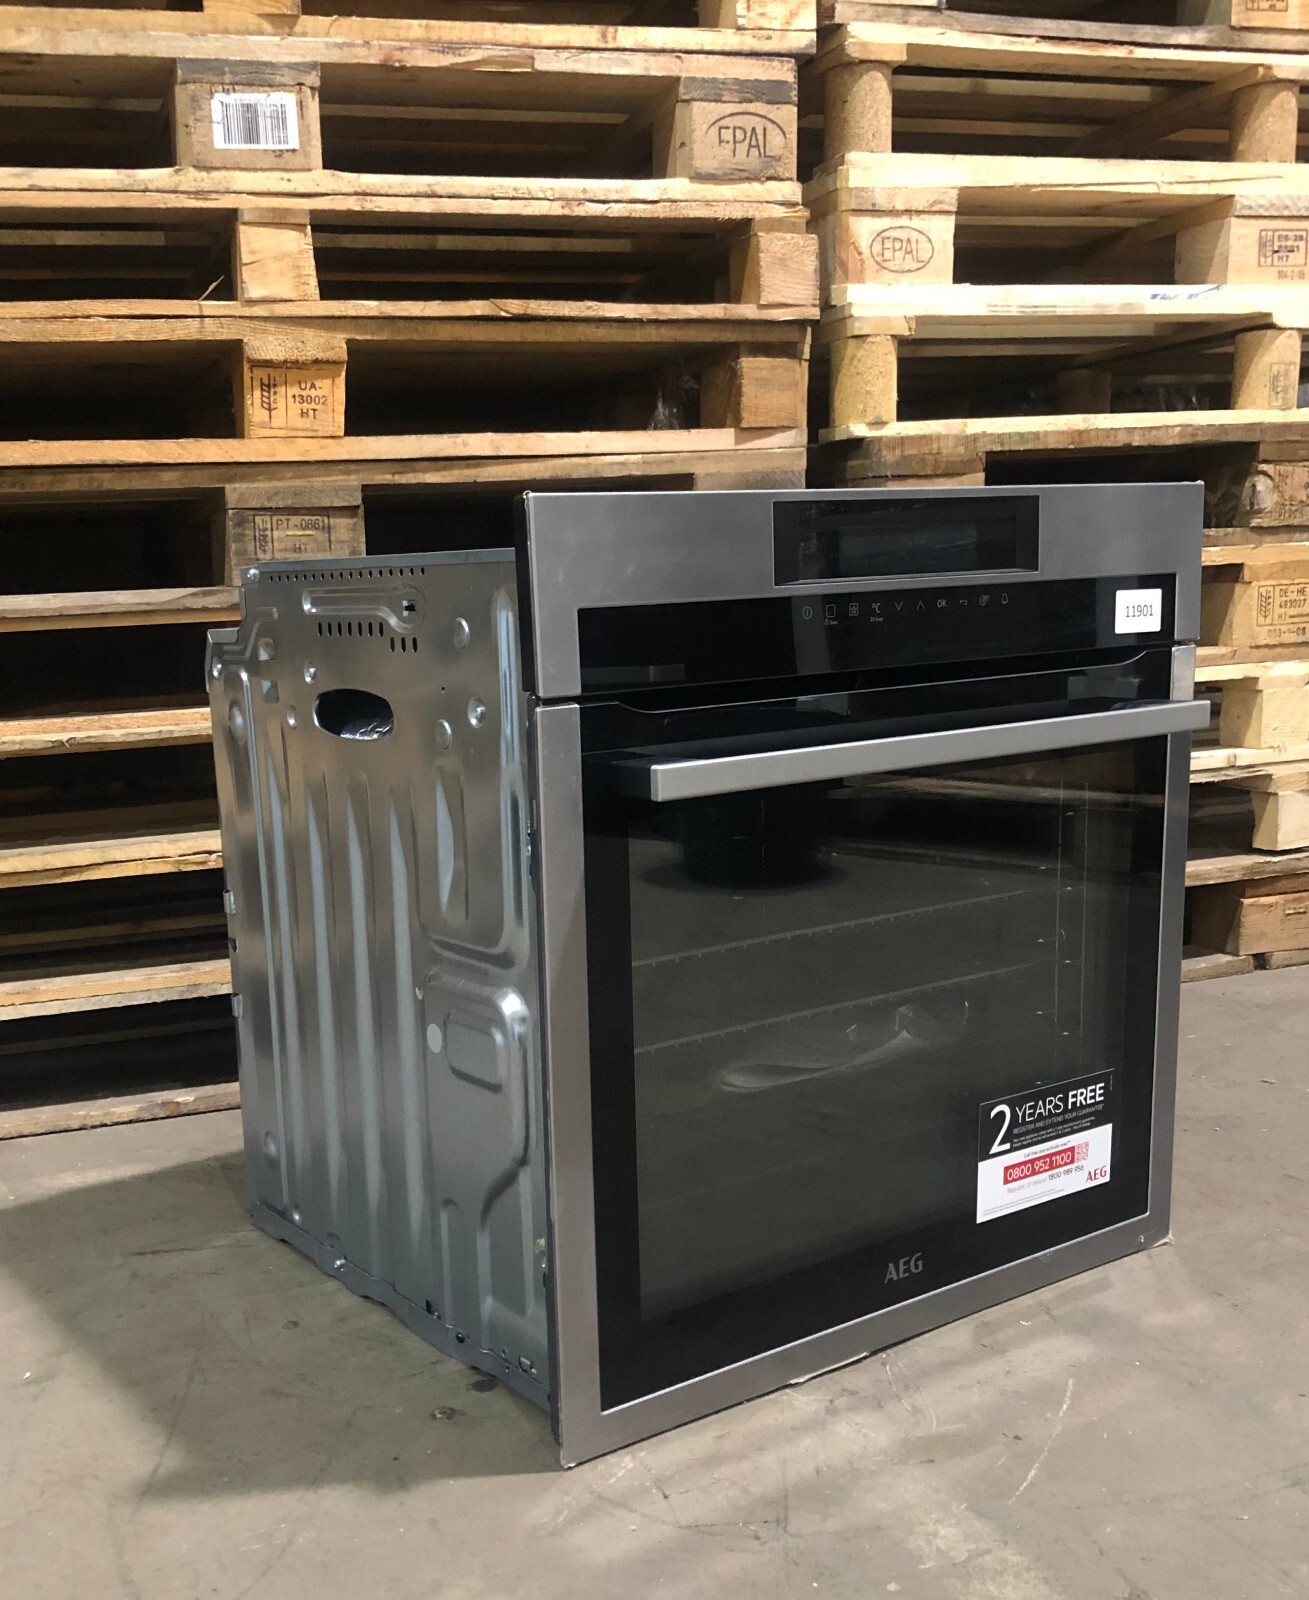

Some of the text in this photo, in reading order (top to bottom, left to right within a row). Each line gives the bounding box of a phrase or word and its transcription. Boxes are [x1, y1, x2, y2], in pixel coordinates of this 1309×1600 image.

[881, 236, 925, 263] EPAL
[298, 380, 322, 392] UA-
[292, 394, 328, 406] 13002
[300, 408, 318, 420] HT
[294, 542, 309, 554] HT
[937, 599, 948, 608] OK
[1126, 604, 1154, 618] 11901
[988, 1104, 1011, 1154] 2
[1016, 1094, 1064, 1124] YEARS
[1068, 1083, 1104, 1110] FREE
[1012, 1123, 1033, 1134] REGISTER
[1035, 1120, 1045, 1128] AND
[1045, 1114, 1063, 1125] EXTEND
[1065, 1111, 1076, 1119] YOUR
[1007, 1152, 1072, 1180] 0800 952 1100
[1048, 1171, 1062, 1181] 1800
[1063, 1168, 1073, 1176] 989
[1086, 1166, 1107, 1184] AEG
[884, 1252, 922, 1284] AEG
